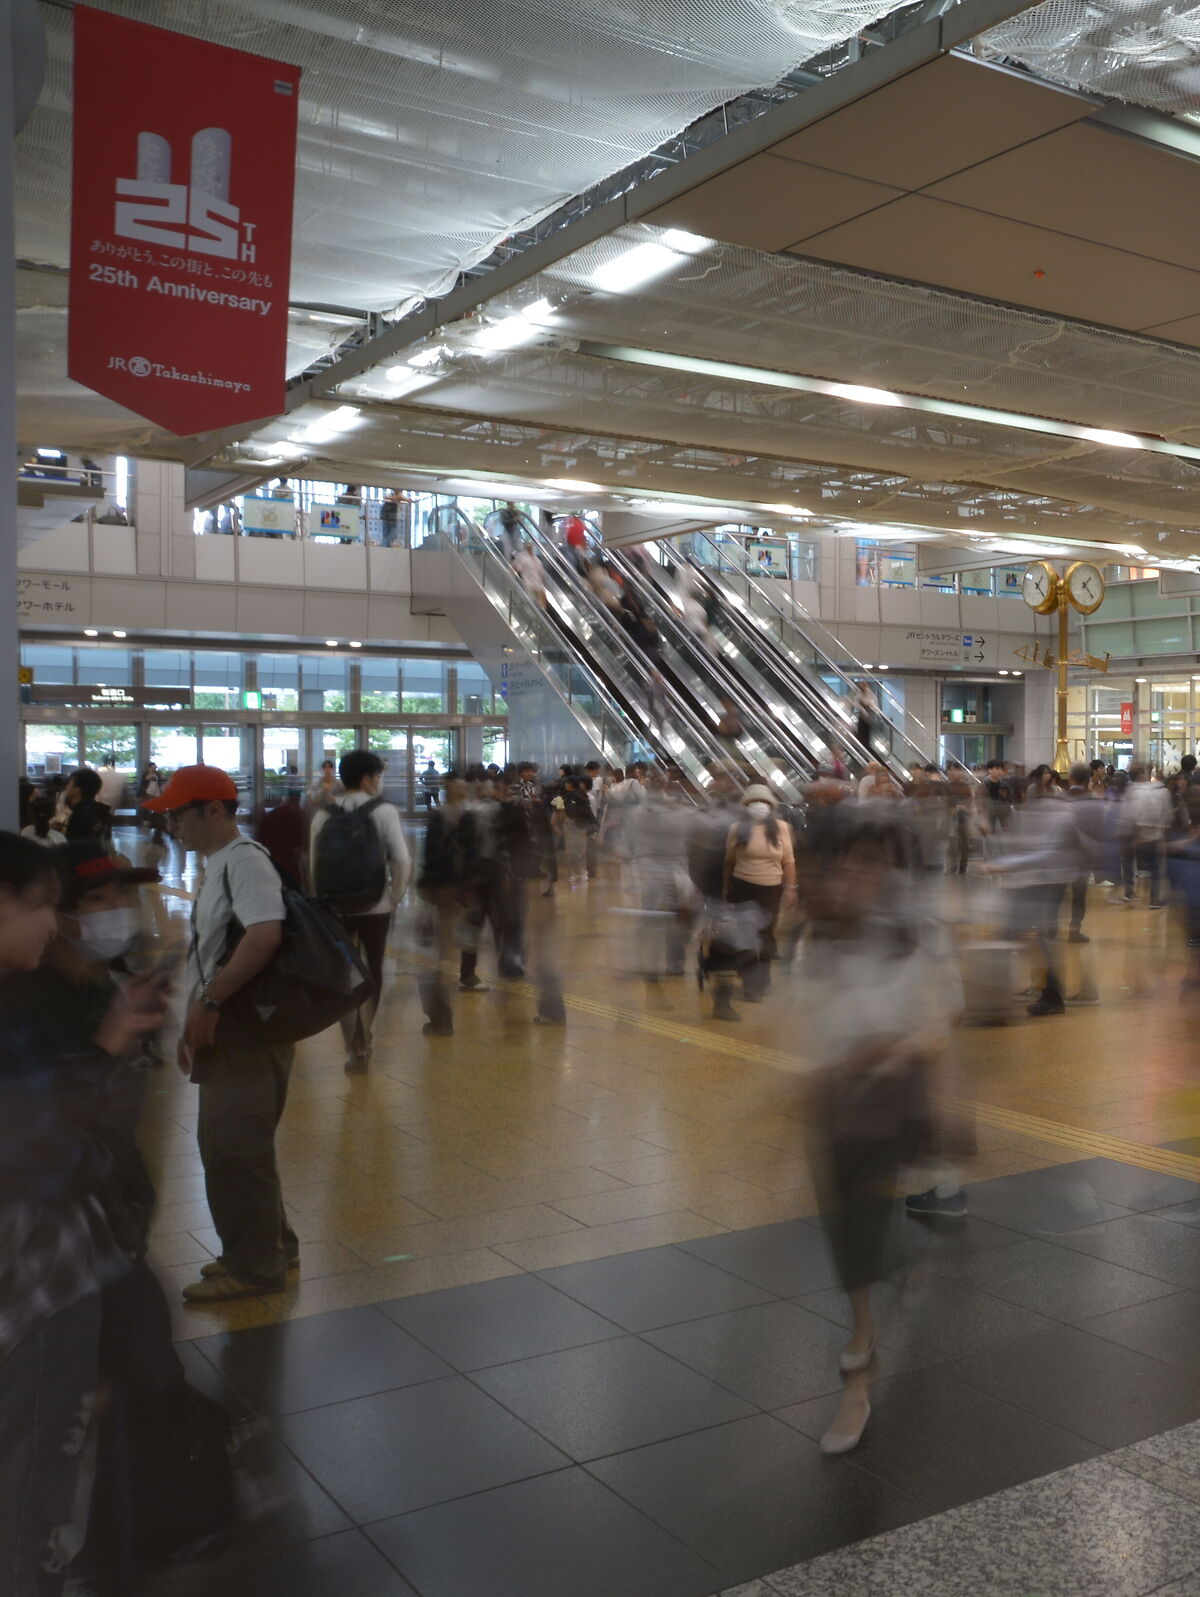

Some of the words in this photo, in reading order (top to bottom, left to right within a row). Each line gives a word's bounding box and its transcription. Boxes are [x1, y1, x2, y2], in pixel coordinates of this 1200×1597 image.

[89, 263, 139, 289] 25th
[147, 275, 272, 316] Anniversary
[152, 363, 251, 393] Takashimaya
[16, 600, 75, 612] ワーホテル
